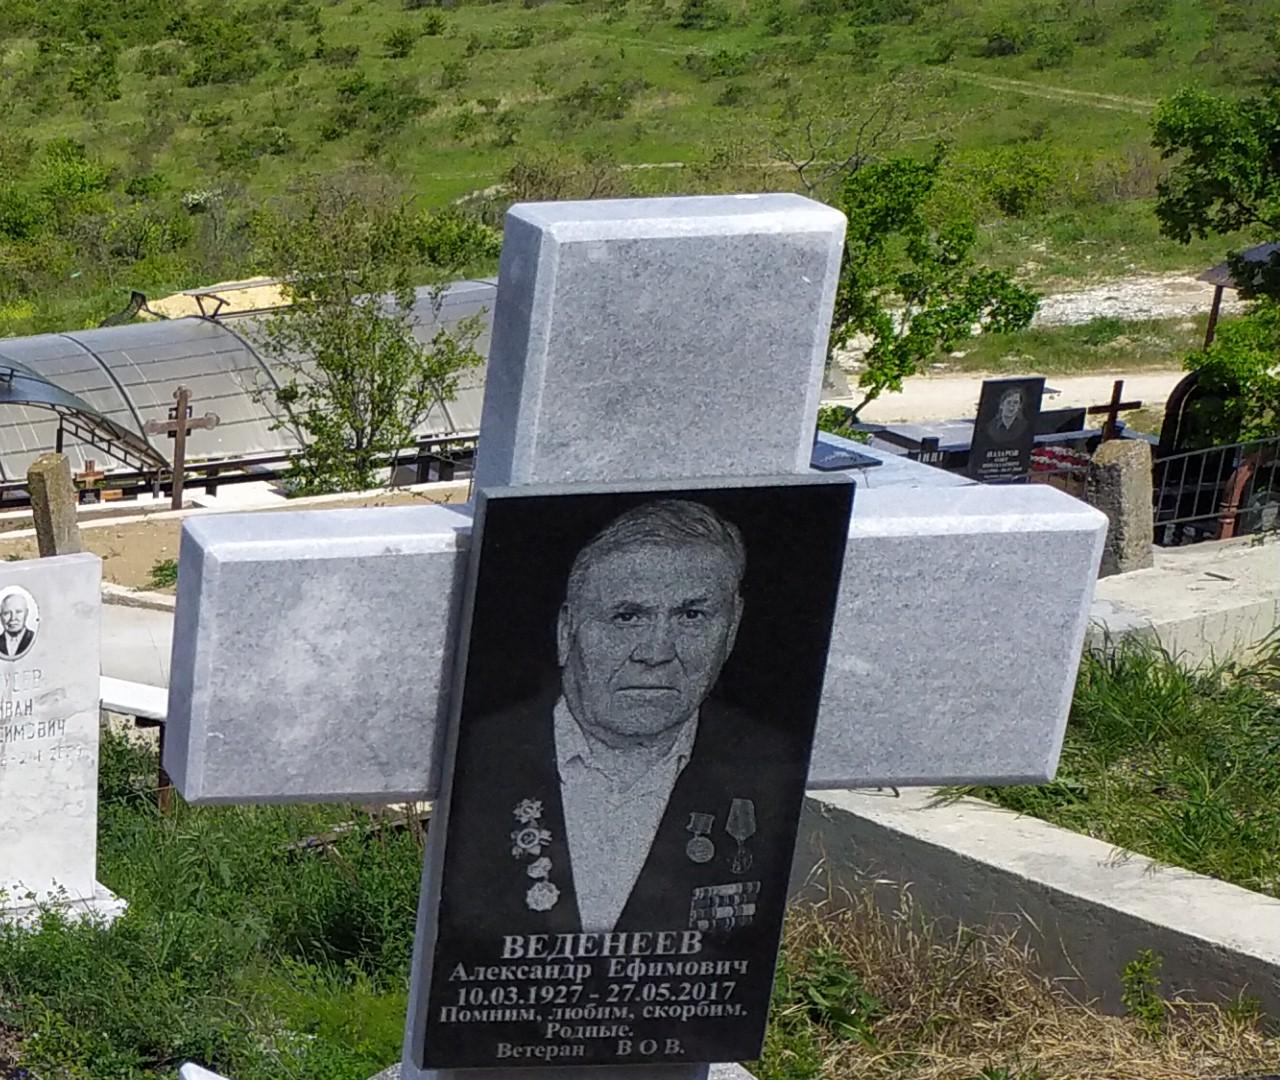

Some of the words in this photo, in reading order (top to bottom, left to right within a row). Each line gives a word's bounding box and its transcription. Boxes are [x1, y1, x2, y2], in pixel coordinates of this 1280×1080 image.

[500, 929, 704, 962] ВЕДЕНЕЕВ
[448, 961, 592, 984] Александр
[607, 958, 749, 983] Ефимович
[458, 985, 584, 1006] 10.03.1927
[606, 981, 737, 1003] 27.05.2017
[439, 1005, 542, 1024] Помним,
[548, 1003, 635, 1022] любим,
[642, 1001, 748, 1022] скорбим.
[544, 1021, 635, 1040] Родные.
[496, 1042, 585, 1061] Ветеран
